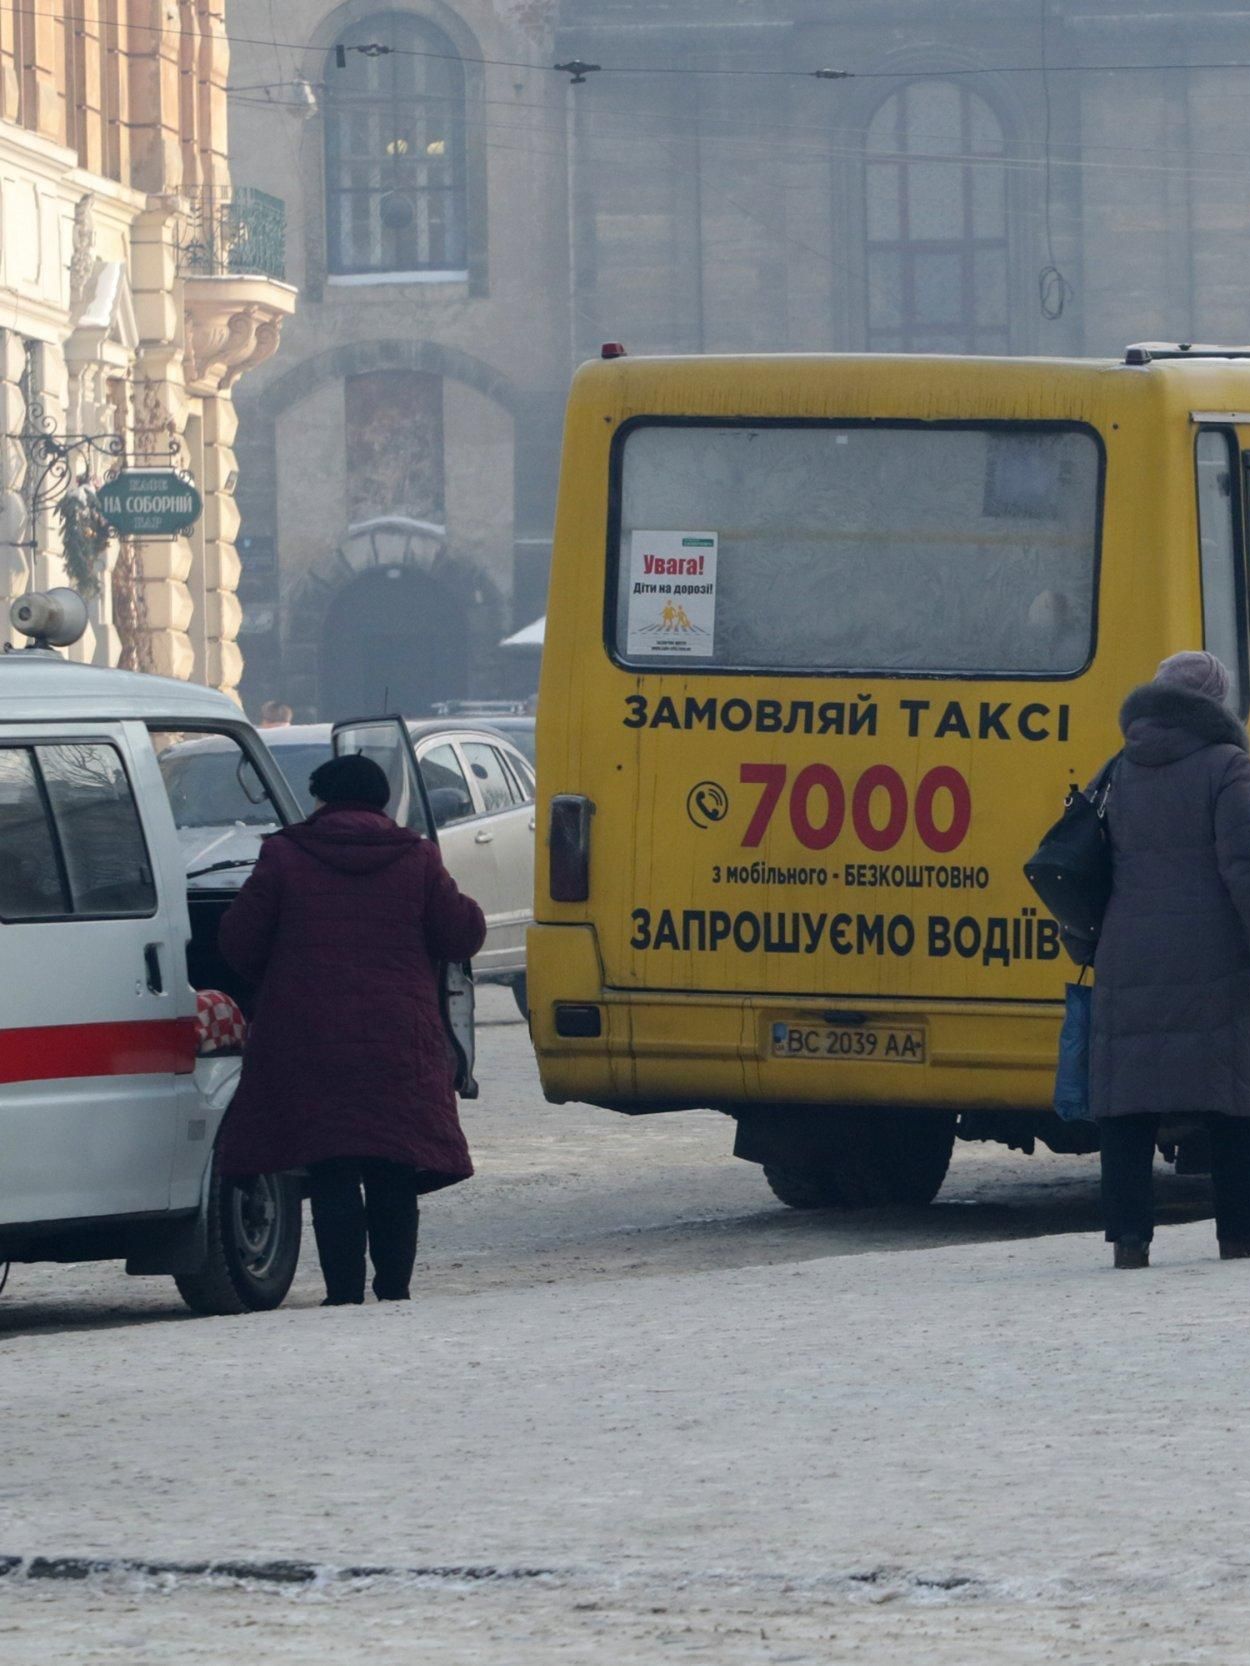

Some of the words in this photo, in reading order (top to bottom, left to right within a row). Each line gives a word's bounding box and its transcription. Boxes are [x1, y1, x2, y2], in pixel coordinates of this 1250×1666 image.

[104, 496, 122, 513] НА
[126, 493, 192, 513] СОБОРНІЙ
[643, 554, 705, 576] Увага!
[633, 582, 657, 595] Діти
[658, 583, 672, 594] на
[673, 583, 713, 595] дорозі!
[622, 693, 878, 737] ЗАМОВЛЯЙ
[899, 699, 1070, 742] ТАКСІ
[739, 762, 972, 854] 7000
[725, 860, 828, 887] мобільного
[844, 863, 990, 890] БЕЗКОШТОВНО
[629, 907, 916, 958] ЗАПРОШУЄМО
[927, 905, 1061, 968] ВОДІЇВ
[787, 1029, 820, 1053] BC
[826, 1031, 878, 1056] 2039
[884, 1032, 918, 1057] AA
